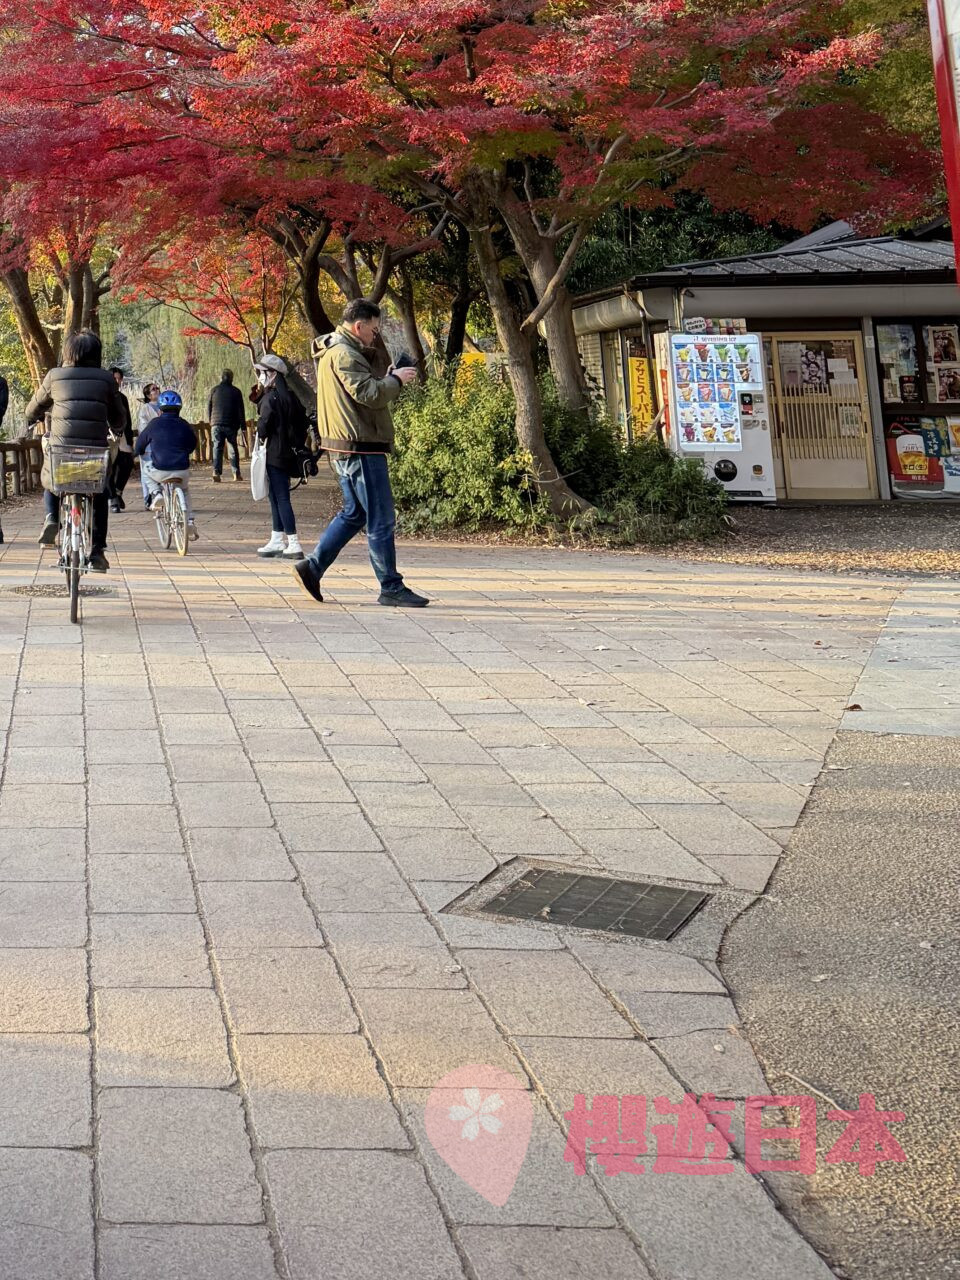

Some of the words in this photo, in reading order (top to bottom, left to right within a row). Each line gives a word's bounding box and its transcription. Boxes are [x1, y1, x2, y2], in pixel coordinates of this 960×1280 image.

[634, 359, 650, 435] アサヒスーパード
